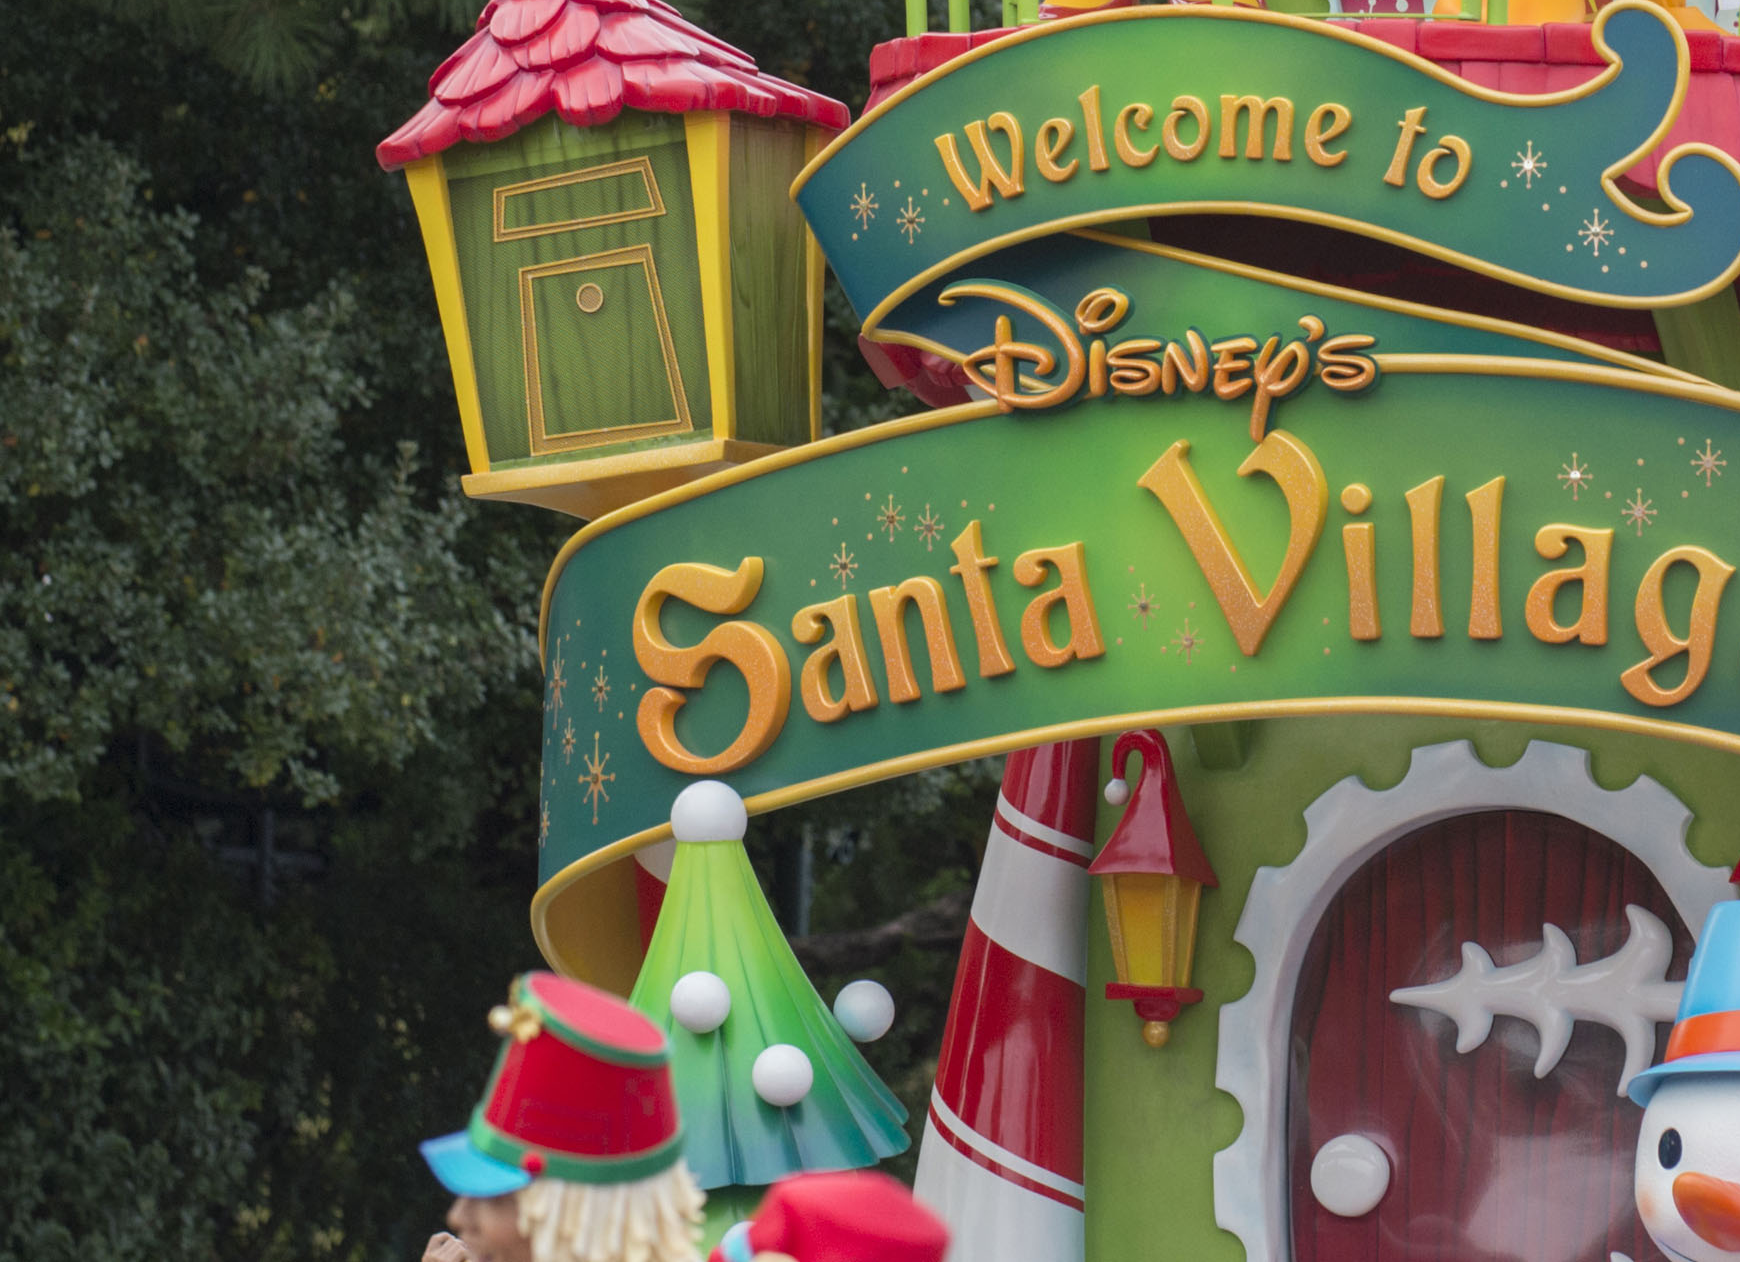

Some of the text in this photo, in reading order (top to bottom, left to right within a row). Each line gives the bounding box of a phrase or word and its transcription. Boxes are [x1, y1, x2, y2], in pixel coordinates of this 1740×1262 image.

[935, 84, 1473, 211] Welcome to
[938, 280, 1378, 440] Disney's
[632, 520, 1105, 774] Santa
